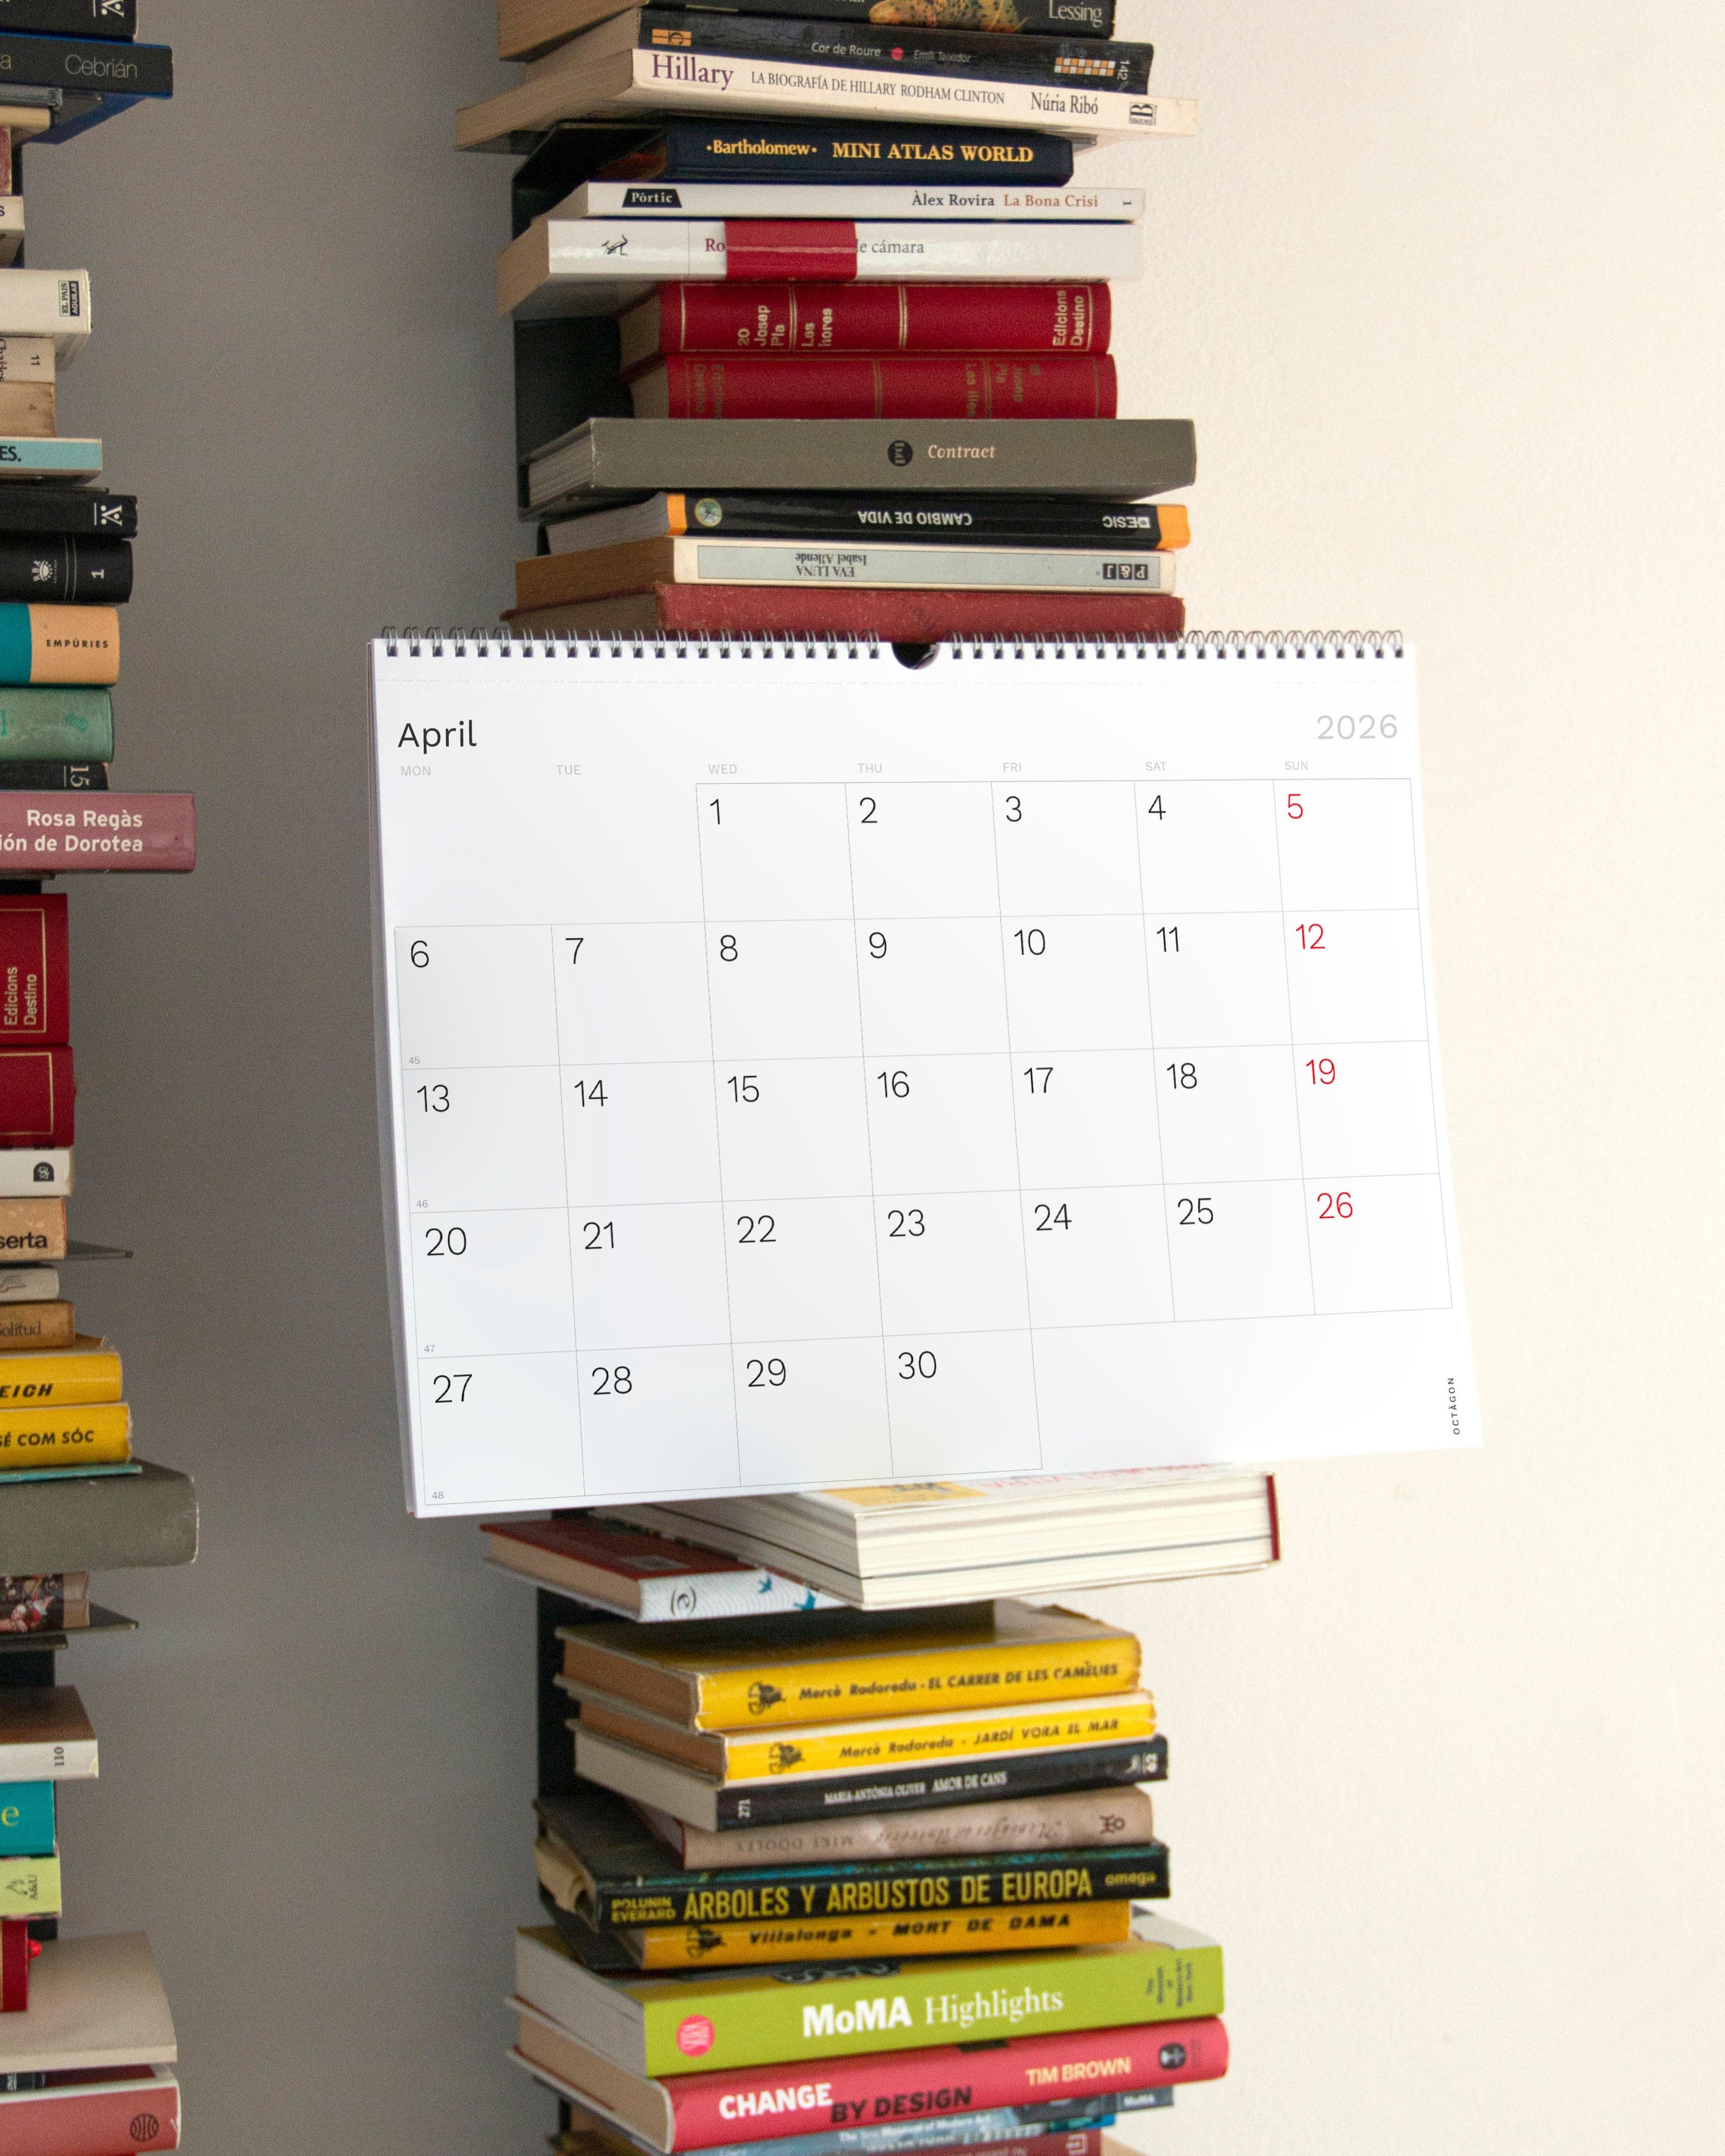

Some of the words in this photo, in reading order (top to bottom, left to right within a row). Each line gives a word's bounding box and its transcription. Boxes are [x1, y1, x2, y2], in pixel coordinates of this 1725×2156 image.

[1048, 0, 1103, 27] Lessing
[812, 42, 831, 54] Cor
[833, 43, 846, 55] de
[849, 44, 881, 57] Roure
[914, 50, 934, 61] Emili
[938, 51, 971, 63] Teixidor
[65, 55, 137, 78] Cebrián
[652, 54, 734, 91] Hillary
[1117, 59, 1130, 80] 142
[751, 71, 764, 84] LA
[768, 72, 828, 90] BIOGRAFÍA
[832, 79, 847, 91] DE
[850, 80, 897, 95] HILLARY
[900, 84, 951, 100] RODHAM
[954, 89, 1004, 105] CLINTON
[1030, 91, 1065, 113] Núria
[1069, 95, 1098, 115] Ribó
[832, 142, 880, 159] MINI
[888, 144, 954, 161] ATLAS
[961, 145, 1034, 162] WORLD
[631, 192, 673, 204] Pòrtic
[912, 190, 944, 207] Àlex
[948, 193, 995, 207] Rovira
[1004, 194, 1020, 207] La
[1025, 195, 1060, 207] Bona
[1065, 195, 1098, 207] Crisi
[871, 239, 924, 254] cámara
[61, 304, 69, 314] EL
[71, 282, 80, 315] AGUILAR
[754, 305, 771, 347] Josep
[818, 308, 833, 347] hores
[1053, 289, 1068, 347] Edicions
[1070, 295, 1086, 346] Destino
[738, 328, 750, 346] 20
[771, 324, 786, 347] Pla
[928, 444, 996, 459] Contract
[857, 511, 892, 524] VIDA
[895, 511, 913, 525] DE
[916, 513, 972, 526] CAMBIO
[1102, 516, 1137, 528] ESIC
[794, 552, 834, 565] Allende
[837, 554, 867, 566] Isabel
[31, 560, 41, 582] RBA
[90, 569, 105, 579] 1
[796, 564, 830, 577] LUNA
[836, 565, 855, 577] EVA
[46, 638, 109, 648] EMPÚRIES
[397, 718, 477, 755] April
[1316, 713, 1398, 740] 2026
[70, 765, 90, 788] 15
[401, 765, 431, 776] MON
[555, 764, 582, 775] TUE
[708, 764, 737, 774] WED
[857, 763, 882, 774] THU
[1003, 762, 1022, 773] FRI
[1145, 761, 1167, 771] SAT
[1285, 760, 1308, 770] SUN
[27, 809, 76, 827] Rosa
[83, 809, 143, 831] Regàs
[710, 798, 720, 825] 1
[859, 797, 878, 824] 2
[1005, 795, 1022, 822] 3
[1148, 795, 1166, 820] 4
[1287, 793, 1304, 819] 5
[34, 834, 57, 852] de
[65, 835, 143, 852] Dorotea
[410, 940, 429, 968] 6
[565, 937, 584, 965] 7
[720, 934, 738, 962] 8
[869, 931, 887, 959] 9
[1014, 929, 1046, 956] 10
[1156, 926, 1179, 953] 11
[1295, 923, 1325, 950] 12
[4, 967, 18, 1026] Edicions
[23, 973, 37, 1025] Destino
[408, 1056, 420, 1065] 45
[416, 1084, 450, 1113] 13
[574, 1080, 608, 1108] 14
[727, 1075, 759, 1103] 15
[877, 1070, 910, 1098] 16
[1024, 1067, 1054, 1094] 17
[1166, 1062, 1198, 1090] 18
[1305, 1058, 1336, 1085] 19
[416, 1200, 428, 1208] 46
[425, 1227, 467, 1256] 20
[583, 1221, 614, 1250] 21
[737, 1215, 777, 1244] 22
[888, 1209, 926, 1237] 23
[1034, 1203, 1072, 1231] 24
[1177, 1197, 1214, 1225] 25
[1317, 1191, 1353, 1220] 26
[424, 1344, 435, 1353] 47
[433, 1373, 473, 1404] 27
[592, 1366, 632, 1395] 28
[747, 1358, 786, 1387] 29
[898, 1351, 937, 1380] 30
[1447, 1378, 1460, 1435] OCTÀGON
[17, 1434, 56, 1446] COM
[62, 1428, 95, 1444] SÓC
[432, 1491, 444, 1499] 48
[798, 1686, 841, 1701] Mercè
[849, 1679, 916, 1696] Rodoreda
[927, 1678, 942, 1690] EL
[947, 1673, 1000, 1688] CARRER
[1005, 1671, 1022, 1684] DE
[1026, 1669, 1049, 1682] LES
[839, 1742, 881, 1758] Mercè
[888, 1735, 954, 1753] Rodoreda
[974, 1727, 1014, 1746] JARDÍ
[1021, 1725, 1059, 1739] VORA
[1067, 1723, 1080, 1735] EL
[1088, 1718, 1120, 1732] MAR
[54, 1745, 65, 1767] 110
[932, 1775, 962, 1793] AMOR
[965, 1774, 979, 1789] DE
[981, 1771, 1007, 1787] CANS
[801, 1885, 817, 1914] Y
[826, 1876, 949, 1912] ARBUSTOS
[960, 1873, 992, 1905] DE
[1002, 1868, 1093, 1902] EUROPA
[1104, 1872, 1157, 1888] omega
[612, 1897, 672, 1910] POLUNIN
[612, 1908, 676, 1923] EVERARD
[750, 1927, 853, 1944] Villalonga
[893, 1919, 952, 1936] MORT
[967, 1917, 993, 1932] DE
[1009, 1913, 1070, 1930] DAMA
[802, 1995, 912, 2038] MoMA
[926, 1987, 1064, 2028] Highlights
[1025, 2065, 1058, 2087] TIM
[1061, 2056, 1132, 2082] BROWN
[719, 2082, 833, 2120] CHANGE
[831, 2101, 868, 2124] BY
[874, 2085, 972, 2118] DESIGN
